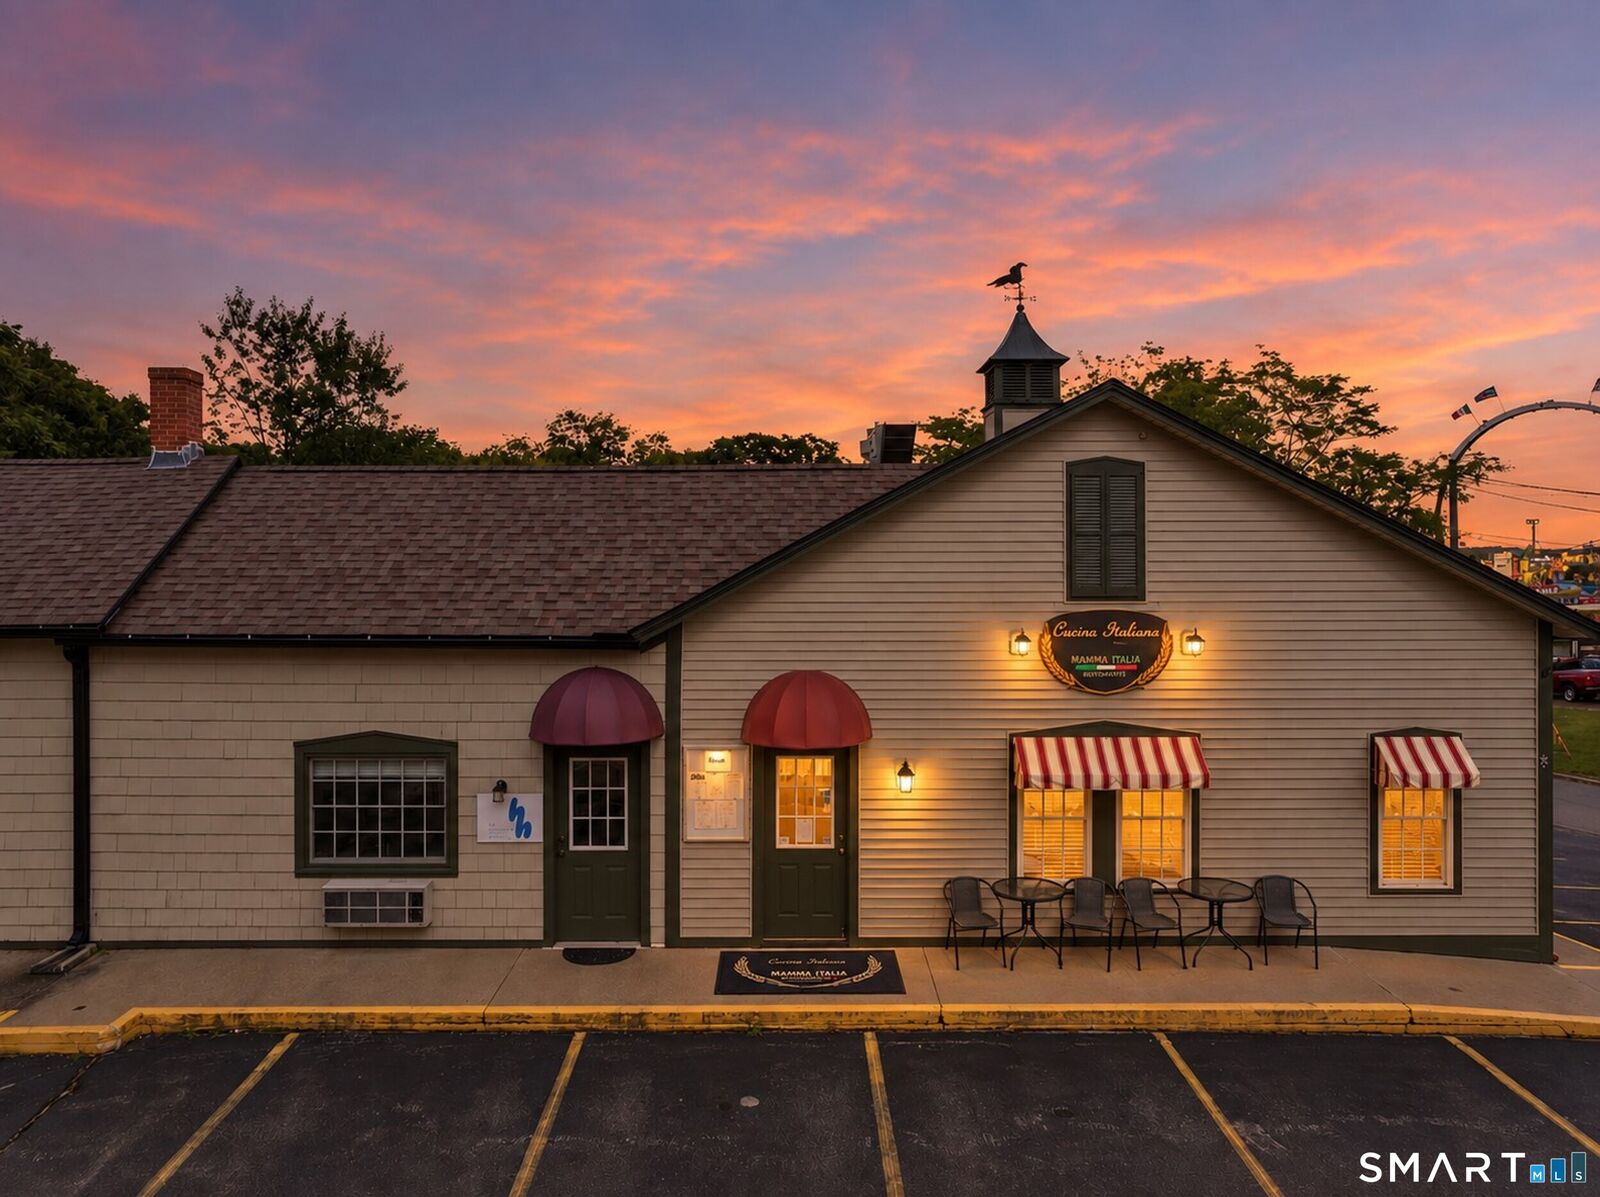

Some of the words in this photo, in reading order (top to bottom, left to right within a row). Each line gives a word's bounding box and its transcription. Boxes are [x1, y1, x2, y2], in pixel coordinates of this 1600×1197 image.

[1053, 621, 1098, 638] Cucina
[1102, 621, 1160, 638] Italiana
[1071, 655, 1108, 664] MAMMA
[1112, 655, 1141, 664] ITALIA
